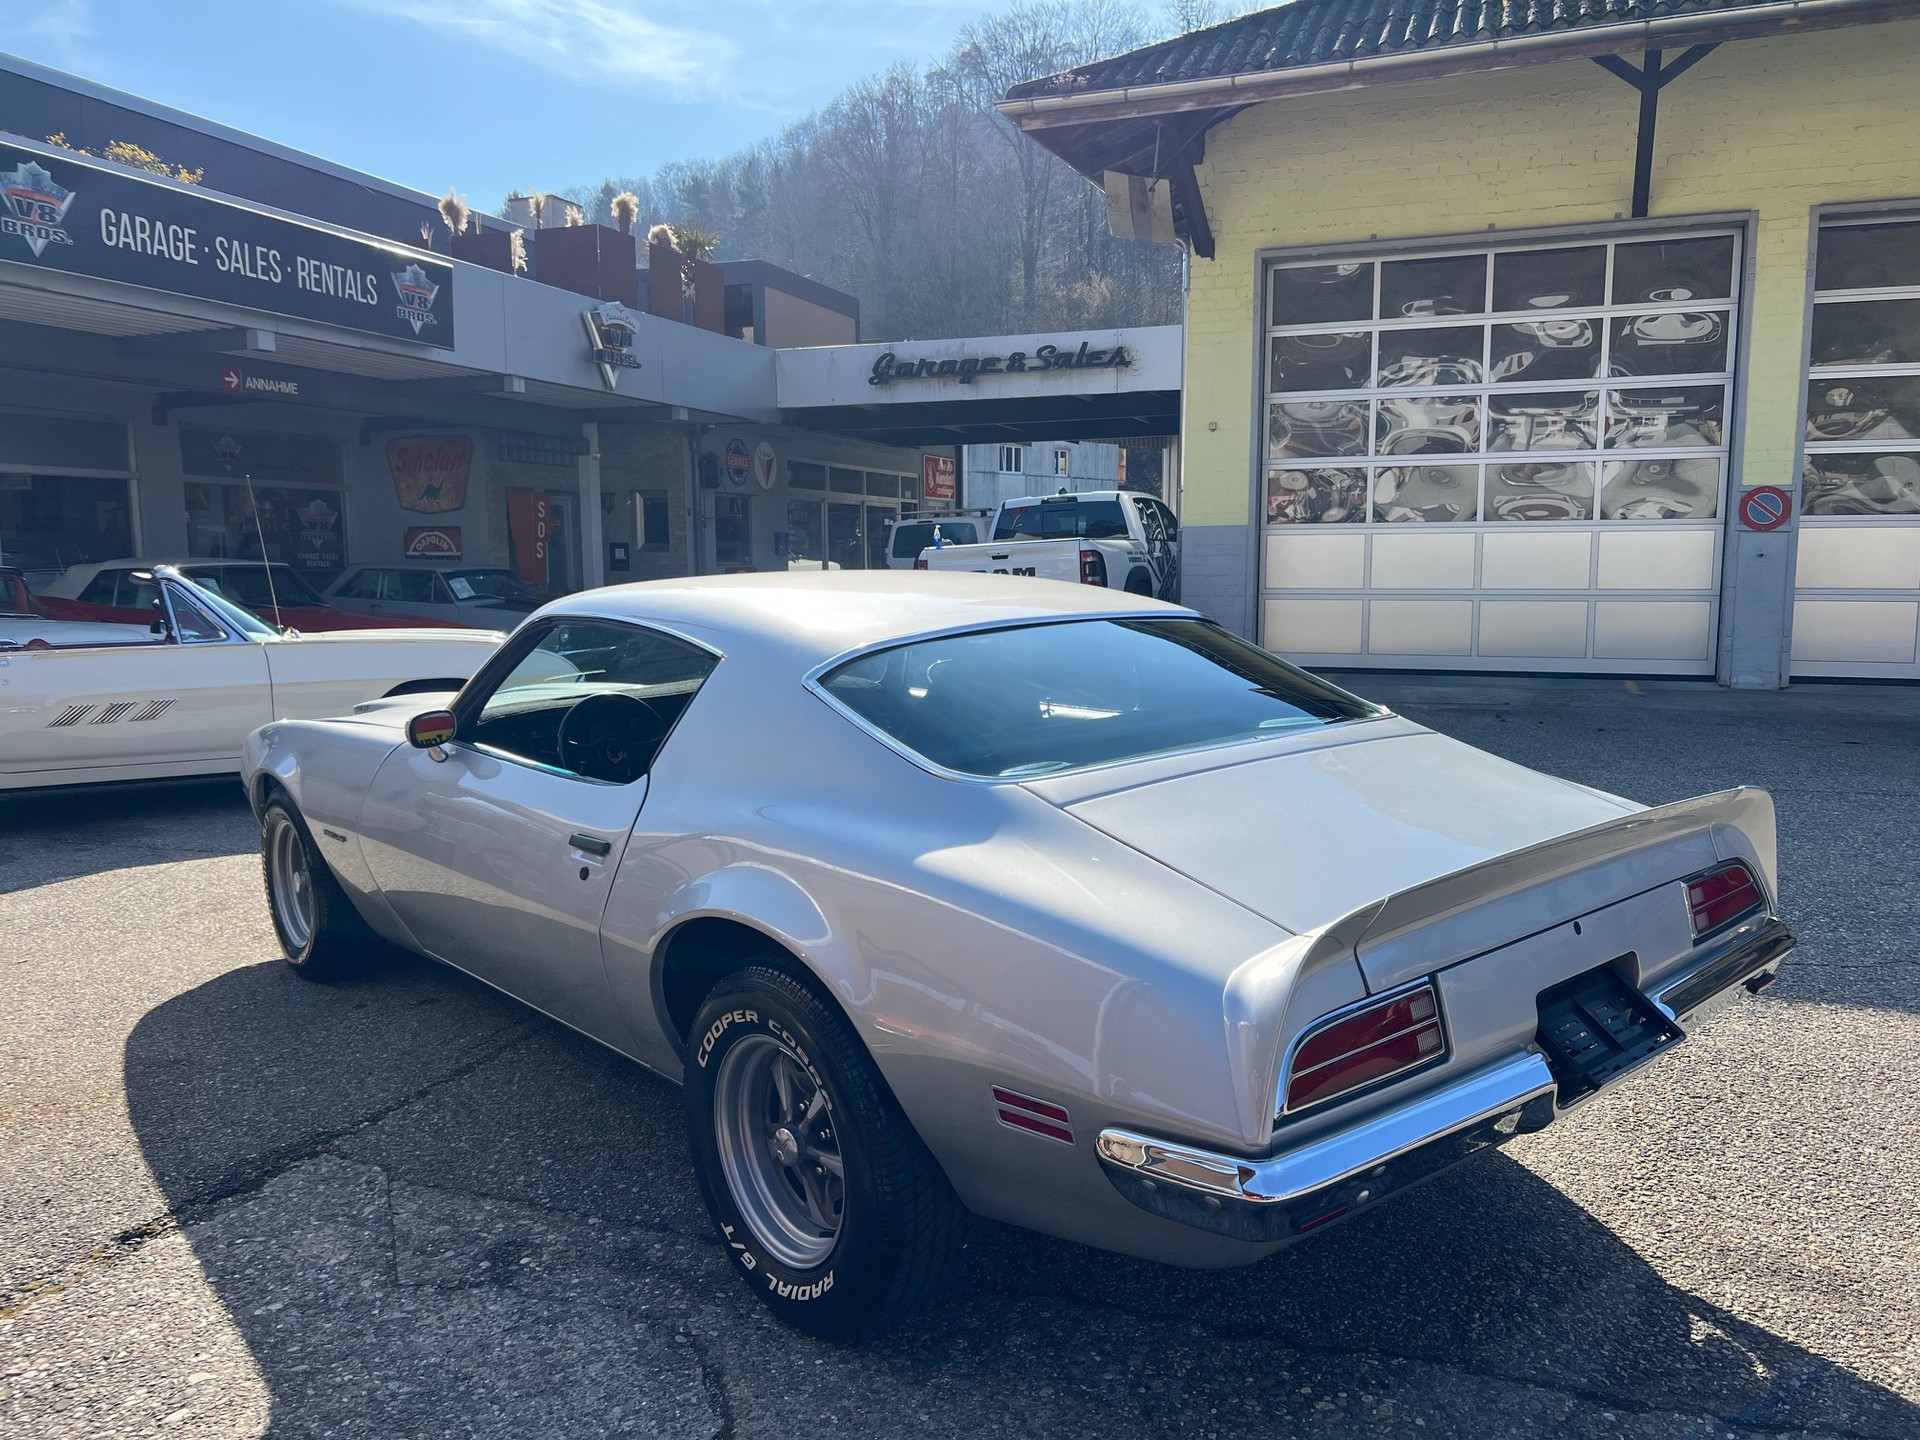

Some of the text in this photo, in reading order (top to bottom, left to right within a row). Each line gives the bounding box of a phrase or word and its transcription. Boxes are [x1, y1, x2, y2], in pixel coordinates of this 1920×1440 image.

[12, 195, 58, 225] V8
[100, 208, 379, 306] GARAGE SALES RENTALS
[402, 290, 431, 311] V8
[868, 341, 1132, 384] Garage & Sales
[245, 376, 299, 395] ANNAHME
[727, 456, 749, 468] SERVICE
[415, 535, 450, 551] DAPOLIN
[535, 501, 546, 559] SOS
[697, 1009, 760, 1068] COOPER
[720, 1222, 834, 1301] RADIAL G/T
